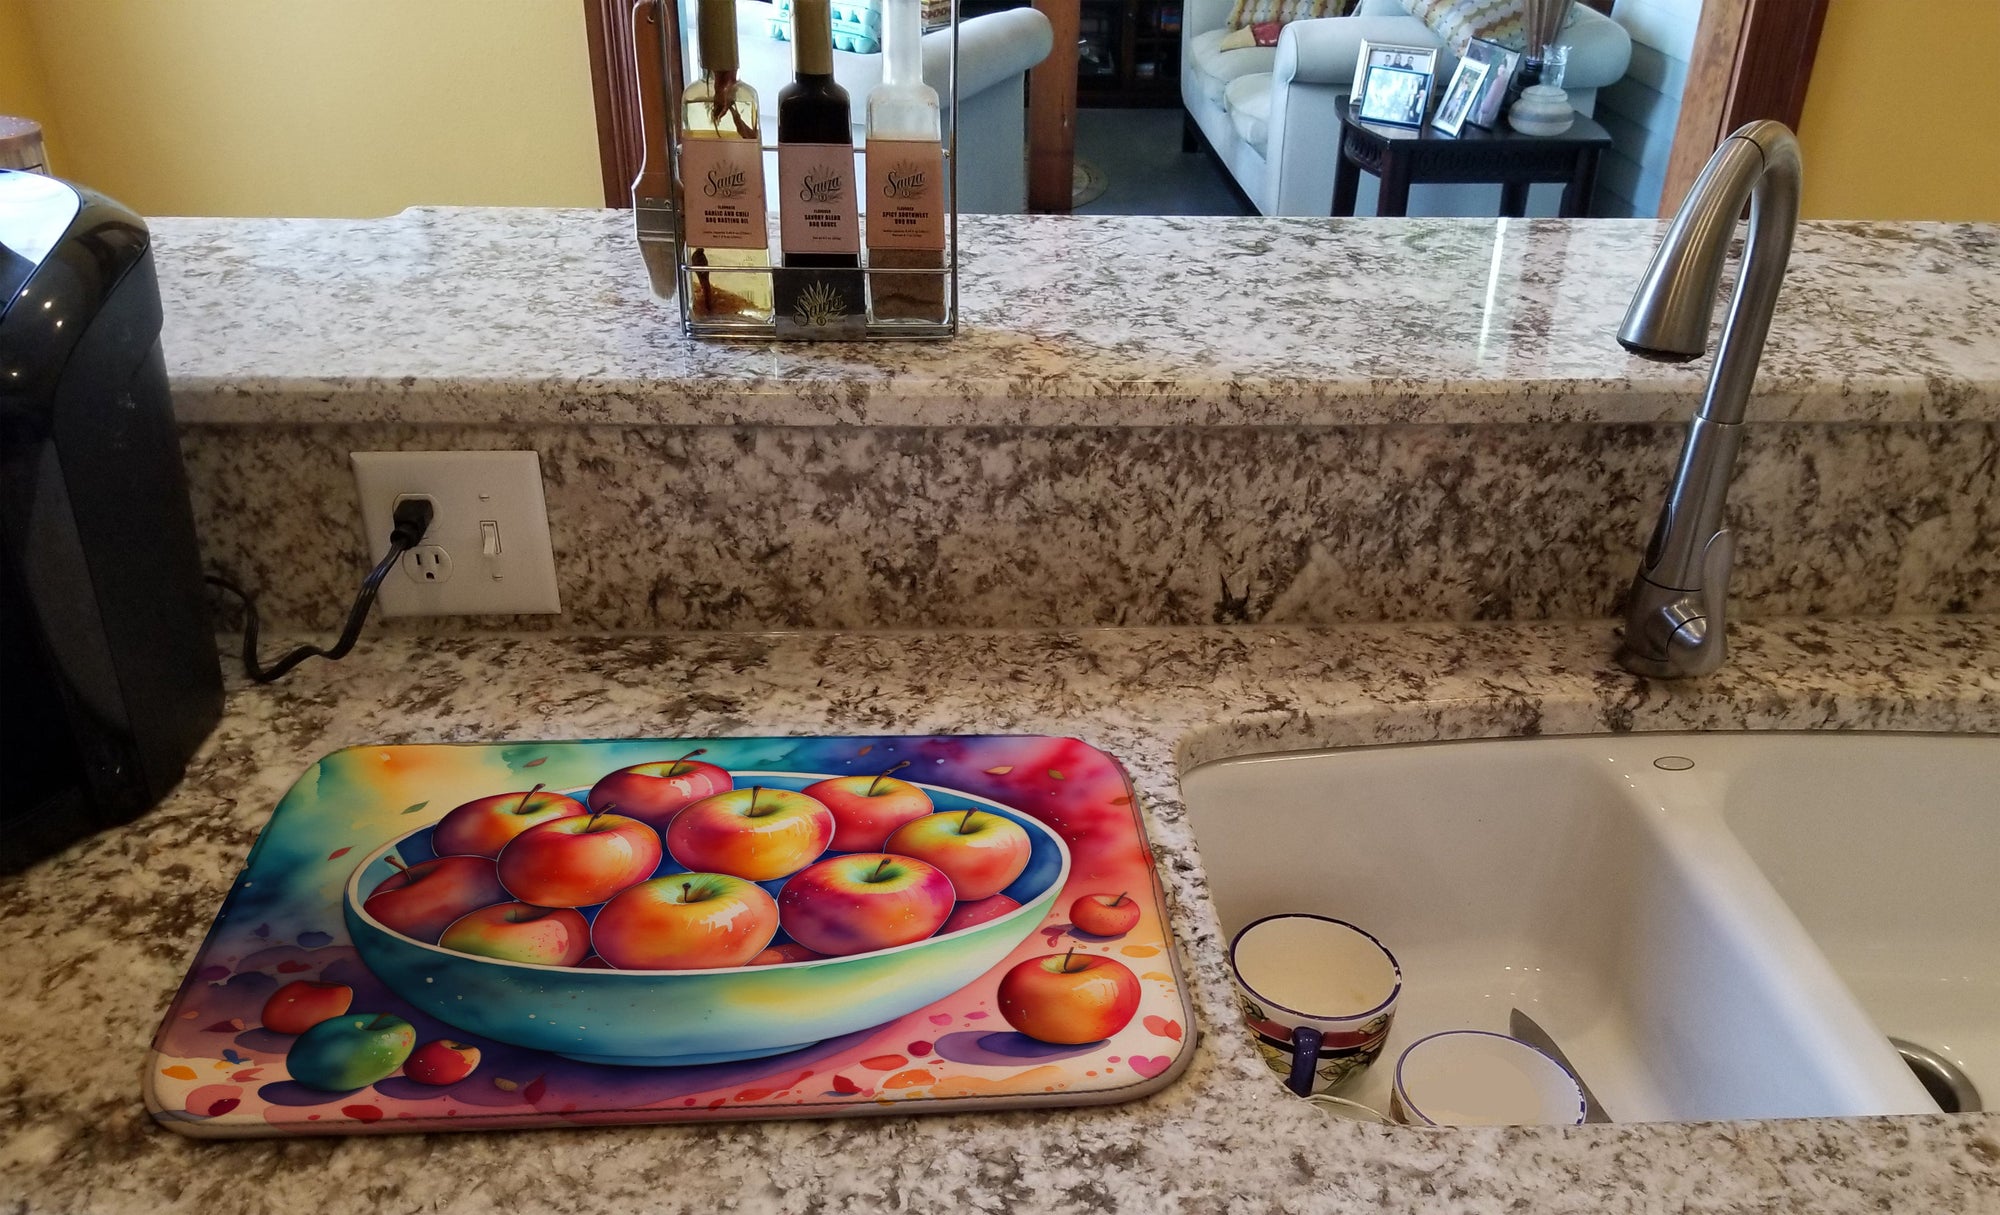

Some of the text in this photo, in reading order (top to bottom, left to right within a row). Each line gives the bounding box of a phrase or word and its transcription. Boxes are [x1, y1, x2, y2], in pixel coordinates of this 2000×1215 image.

[704, 170, 745, 197] Sauza
[800, 175, 841, 202] Sauza
[883, 171, 925, 198] Sauza
